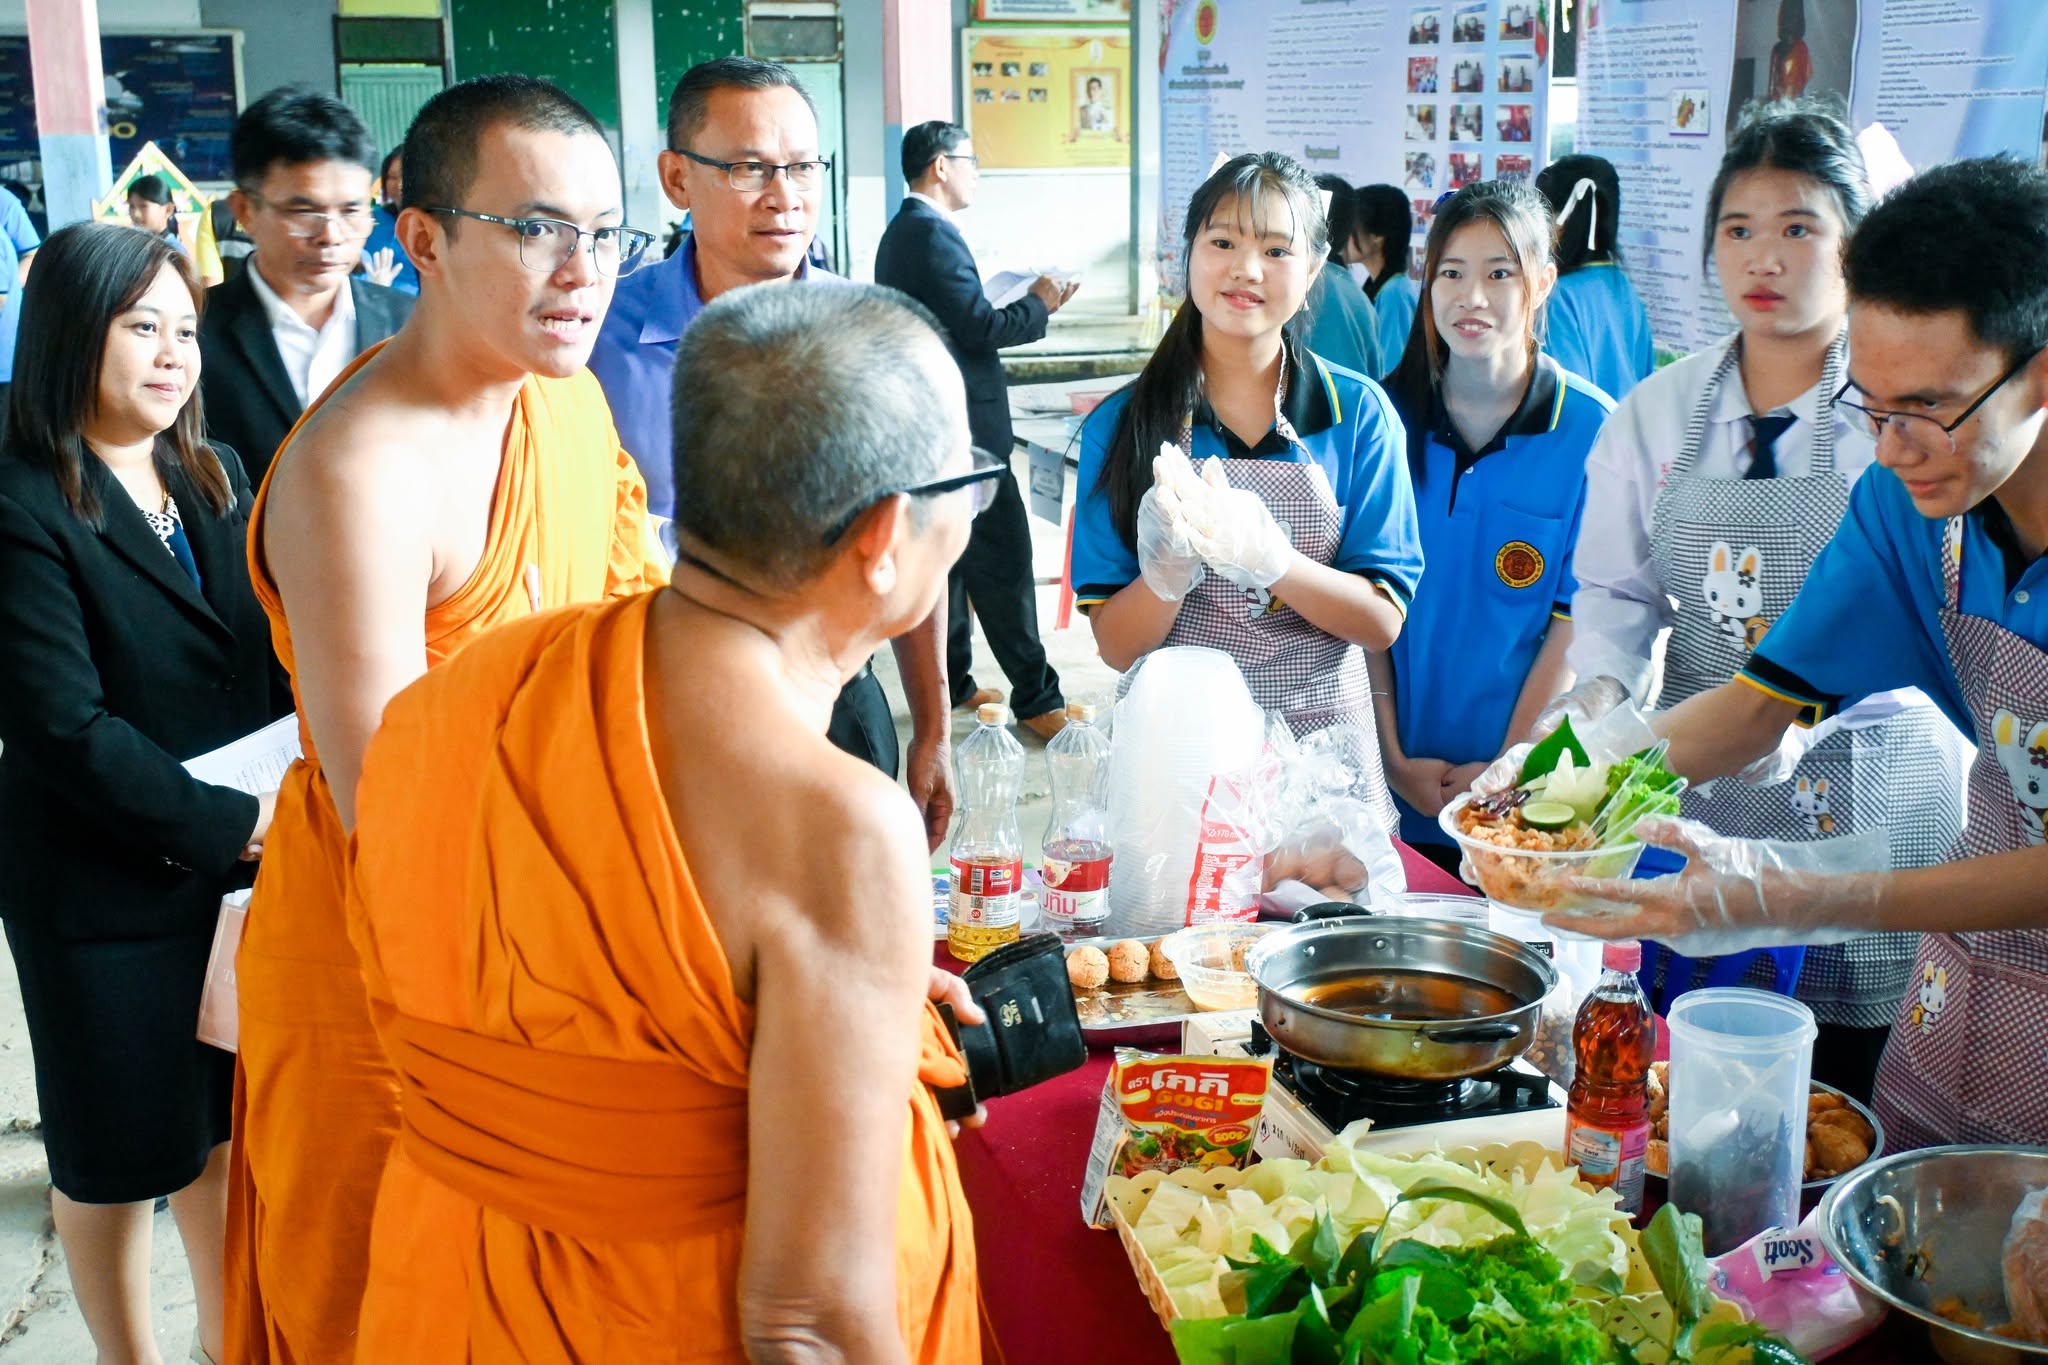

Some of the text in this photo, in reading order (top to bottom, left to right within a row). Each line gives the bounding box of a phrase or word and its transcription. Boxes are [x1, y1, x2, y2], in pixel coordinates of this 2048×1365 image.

[1128, 1069, 1229, 1097] ตรา โกกิ
[1156, 1090, 1224, 1112] GOGI
[1762, 1238, 1815, 1266] Scott
